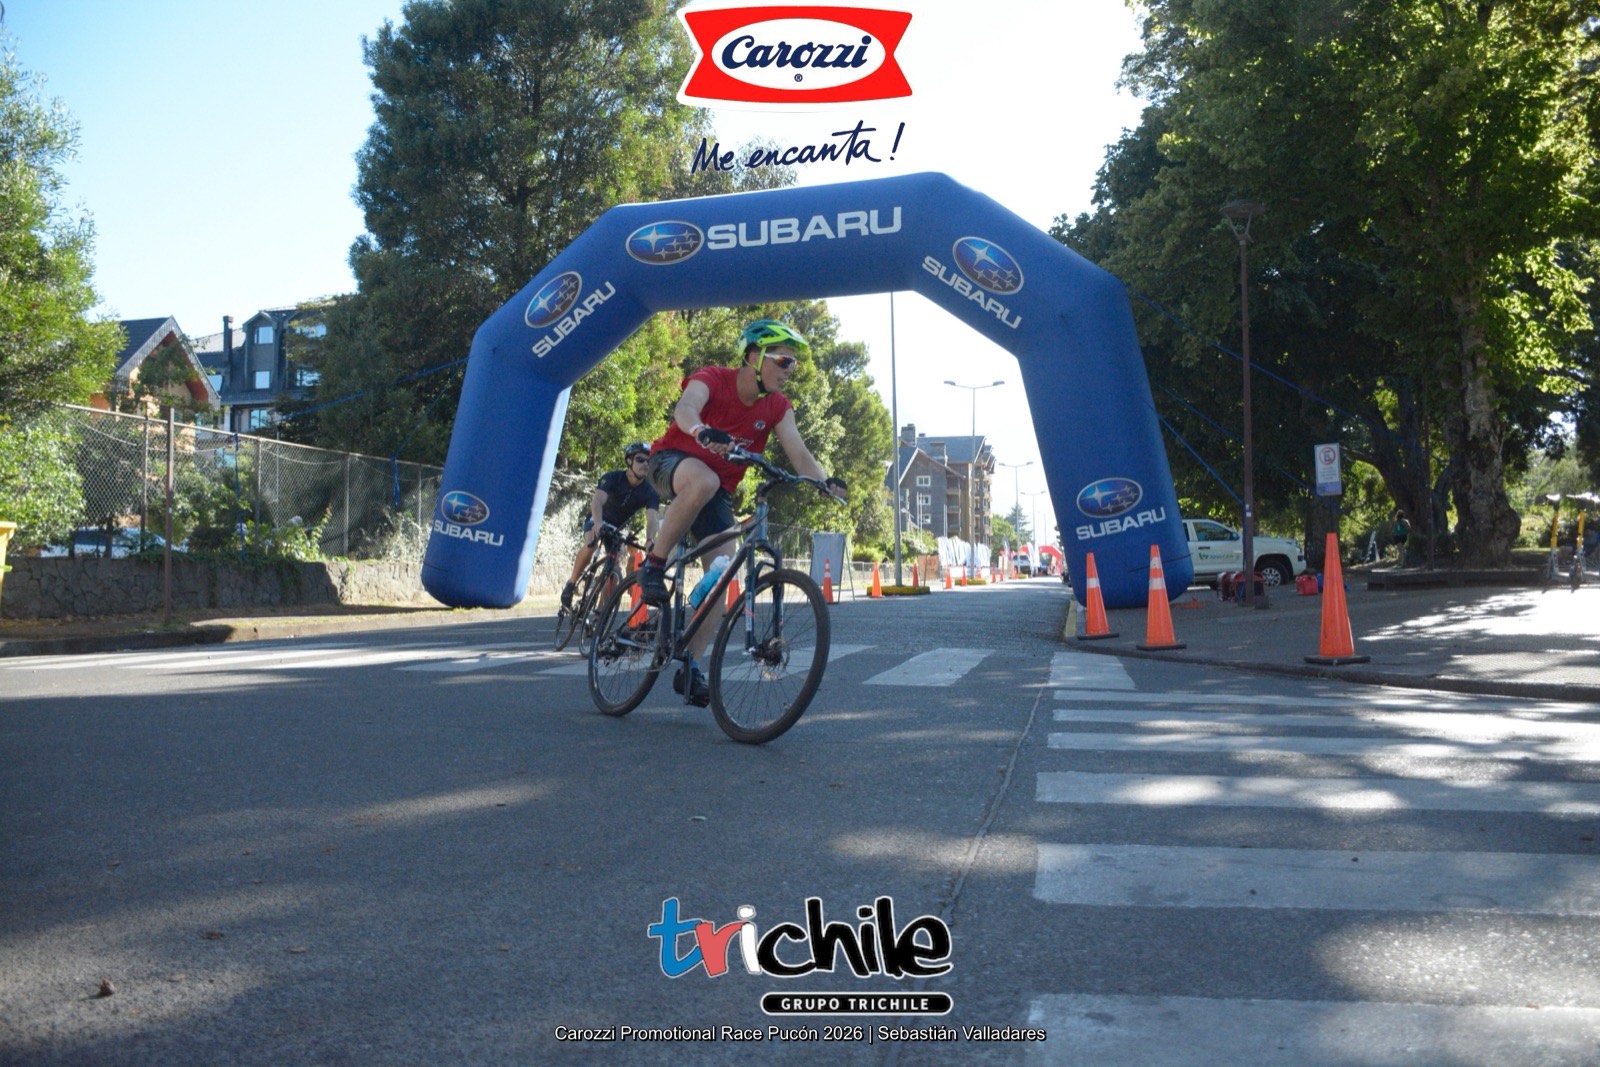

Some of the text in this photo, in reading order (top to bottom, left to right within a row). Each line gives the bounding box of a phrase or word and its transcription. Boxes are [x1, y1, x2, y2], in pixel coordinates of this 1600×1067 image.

[706, 206, 903, 251] SUBARU
[921, 255, 1022, 329] SUBARU
[531, 280, 617, 358] SUBARU
[433, 519, 505, 547] SUBARU
[1075, 506, 1166, 541] SUBARU
